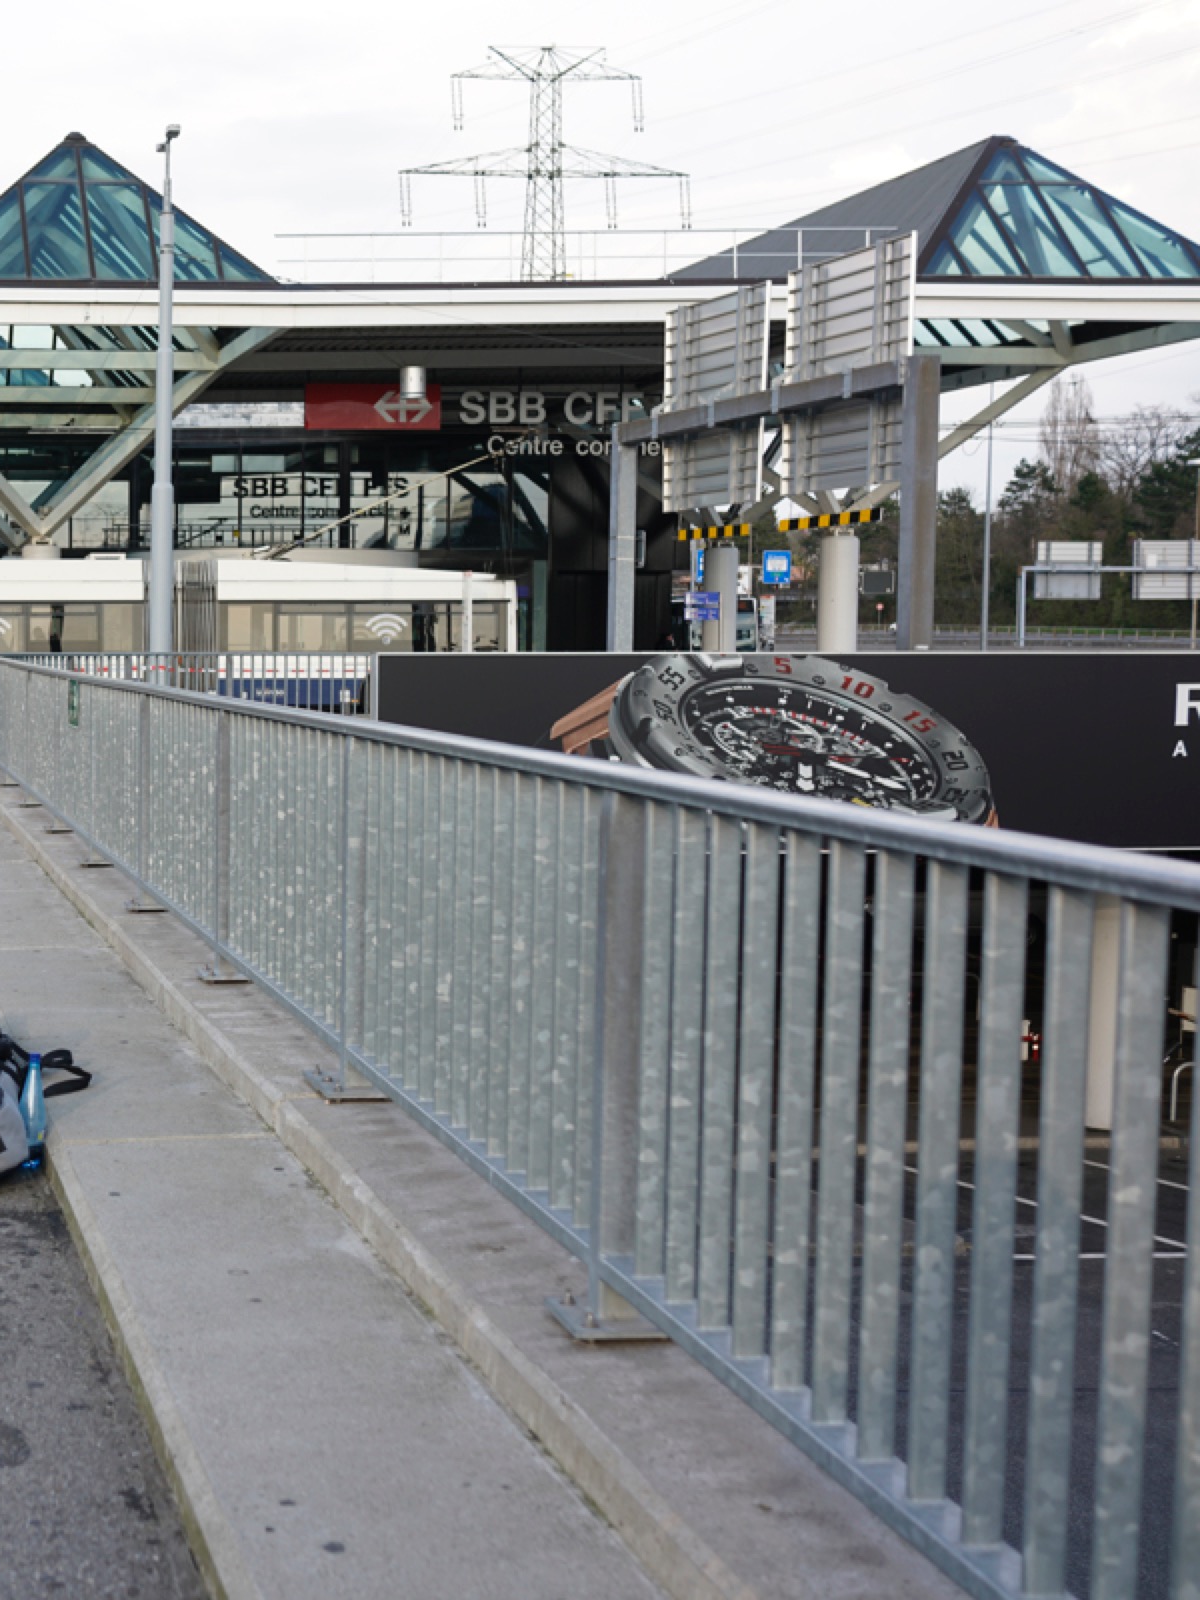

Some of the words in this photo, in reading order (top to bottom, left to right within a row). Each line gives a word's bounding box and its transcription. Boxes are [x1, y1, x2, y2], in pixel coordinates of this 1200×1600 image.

[459, 391, 547, 425] SBB
[563, 391, 644, 425] CFF
[487, 435, 563, 456] Centre
[232, 477, 288, 498] SBB
[773, 655, 793, 675] 5
[657, 665, 686, 691] 55
[840, 674, 876, 700] 10
[903, 709, 938, 733] 15
[1171, 739, 1189, 758] A
[942, 749, 970, 771] 20
